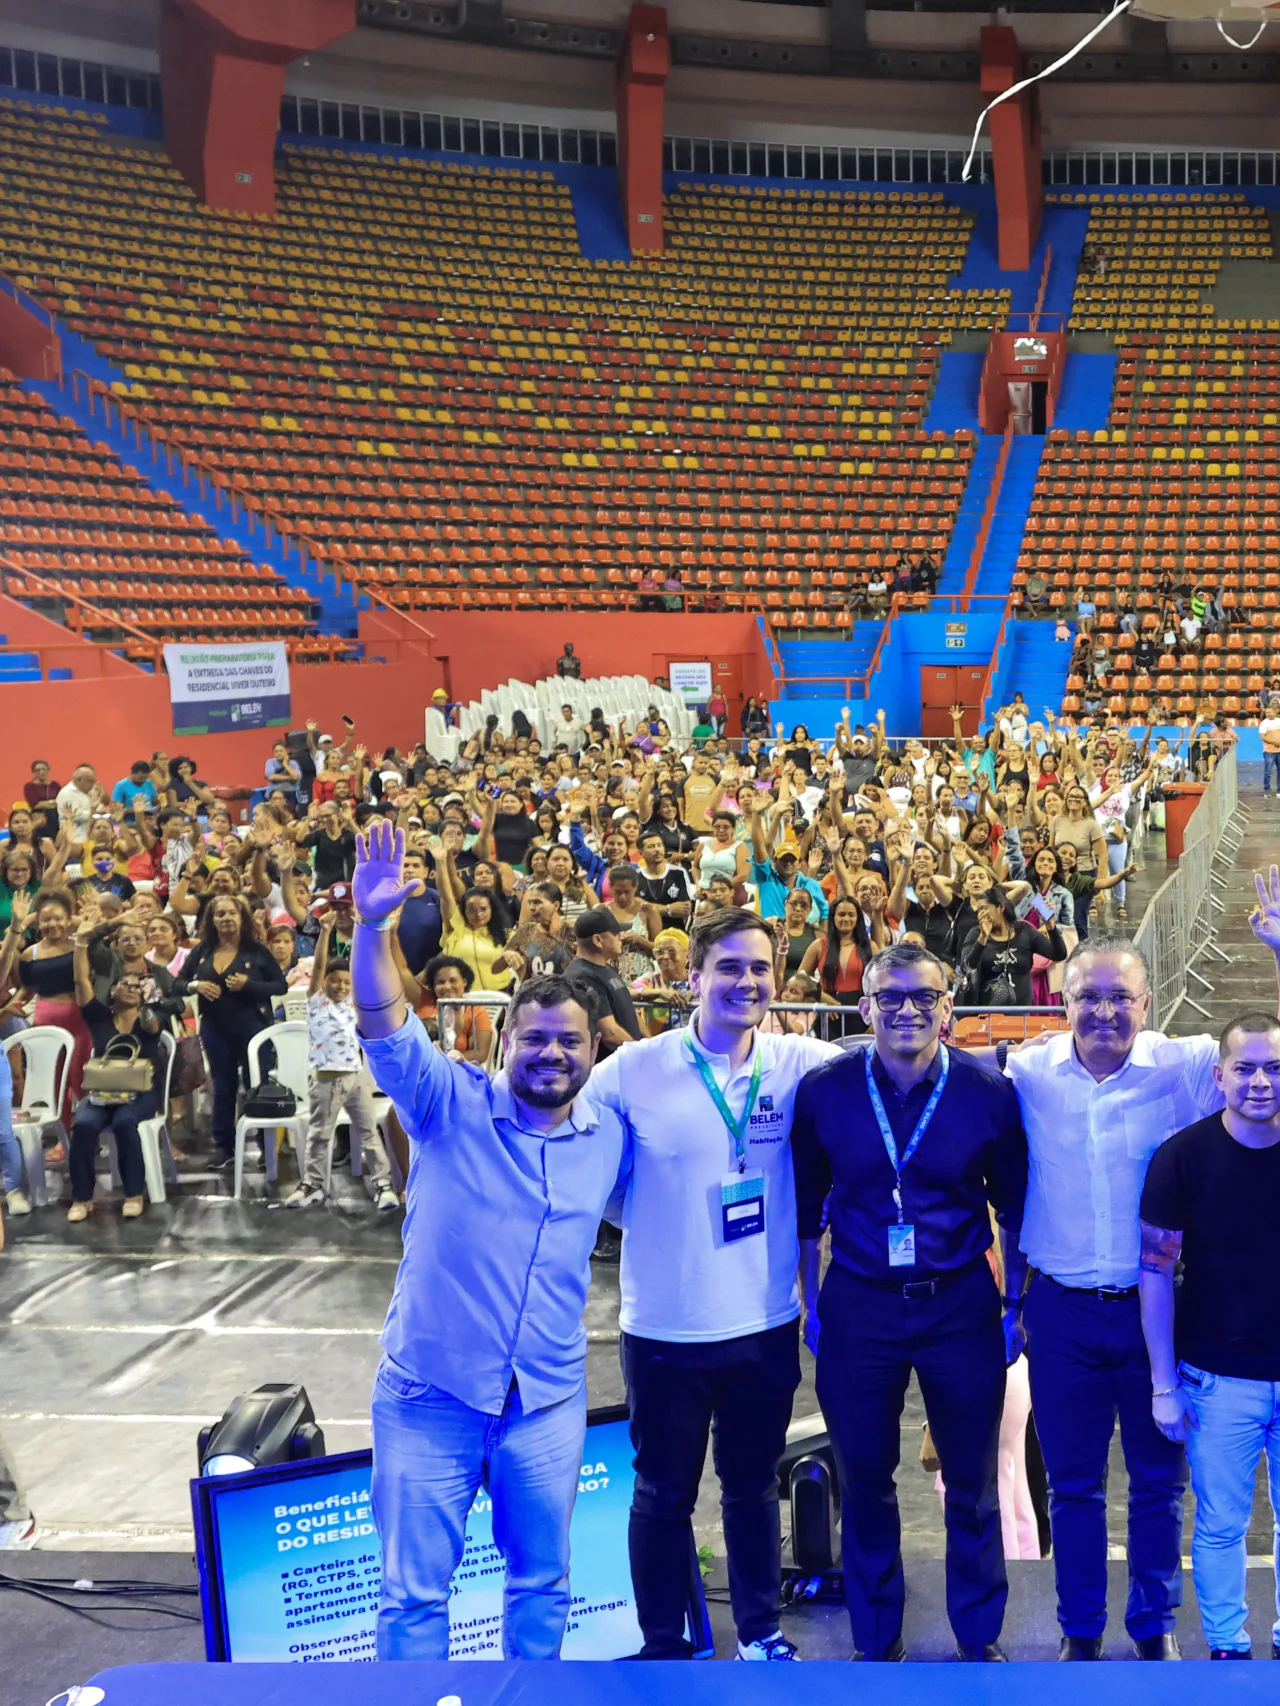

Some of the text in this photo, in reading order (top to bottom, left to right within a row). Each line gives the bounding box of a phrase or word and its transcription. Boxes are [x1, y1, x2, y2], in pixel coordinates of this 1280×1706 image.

[187, 665, 273, 678] A ENTREGA DAS CHAVES DO
[186, 678, 276, 692] RESIDENCIAL VIVER OUTEIRO
[750, 1111, 783, 1124] BELÉM
[749, 1136, 783, 1145] Habitação
[274, 1489, 370, 1518] Beneficiá
[275, 1506, 372, 1535] O QUE LE
[277, 1523, 377, 1552] DO RESID
[293, 1554, 375, 1576] Carteira de
[282, 1579, 313, 1593] (RG,
[316, 1569, 360, 1584] CTPS,
[295, 1586, 343, 1601] Termo
[346, 1582, 364, 1591] de
[285, 1591, 382, 1617] apartamento
[571, 1599, 628, 1617] entrega;
[286, 1606, 366, 1629] assinatura
[303, 1651, 335, 1662] Pelo
